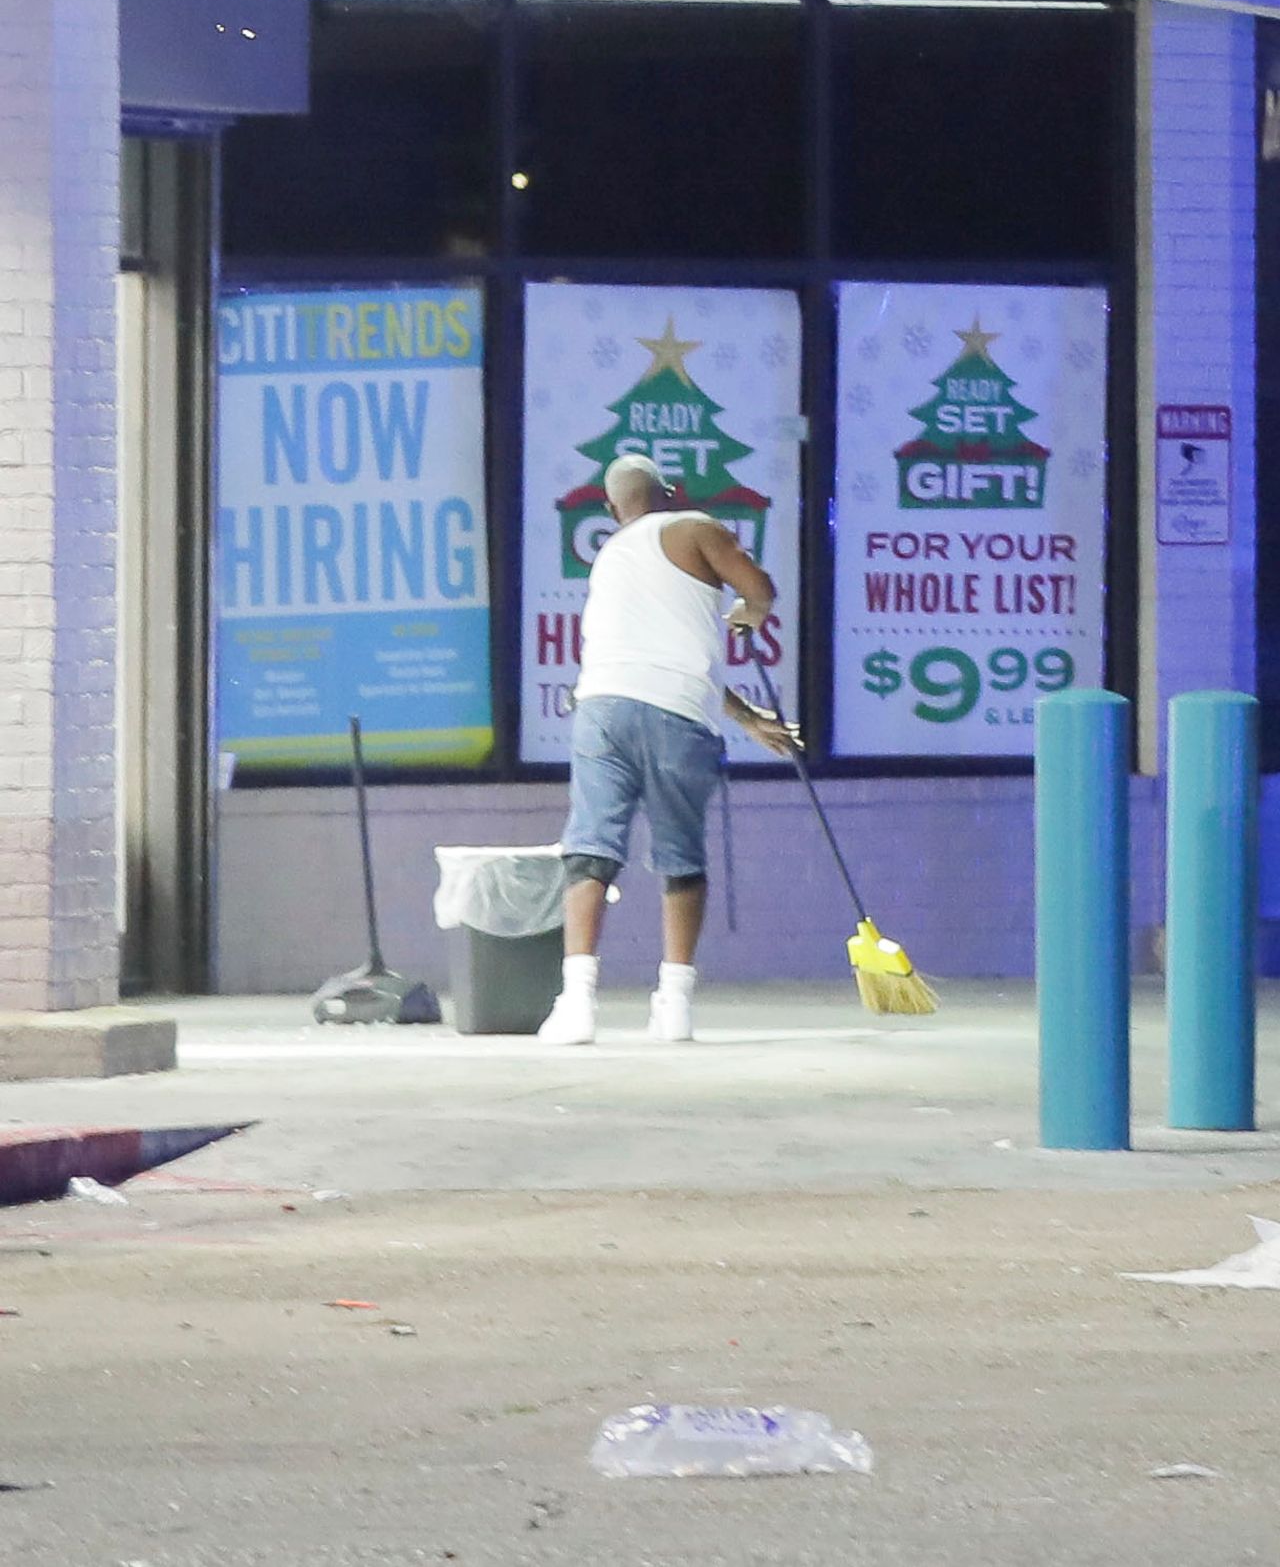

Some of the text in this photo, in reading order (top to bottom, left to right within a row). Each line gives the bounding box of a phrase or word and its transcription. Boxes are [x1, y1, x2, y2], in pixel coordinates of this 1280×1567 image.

[263, 380, 429, 484] NOW
[629, 401, 705, 432] READY
[936, 404, 1015, 433] SET
[907, 462, 1039, 502] GIFT!
[220, 496, 475, 607] HIRING
[867, 532, 1077, 561] FOR YOUR
[865, 572, 1076, 615] WHOLE LIST!
